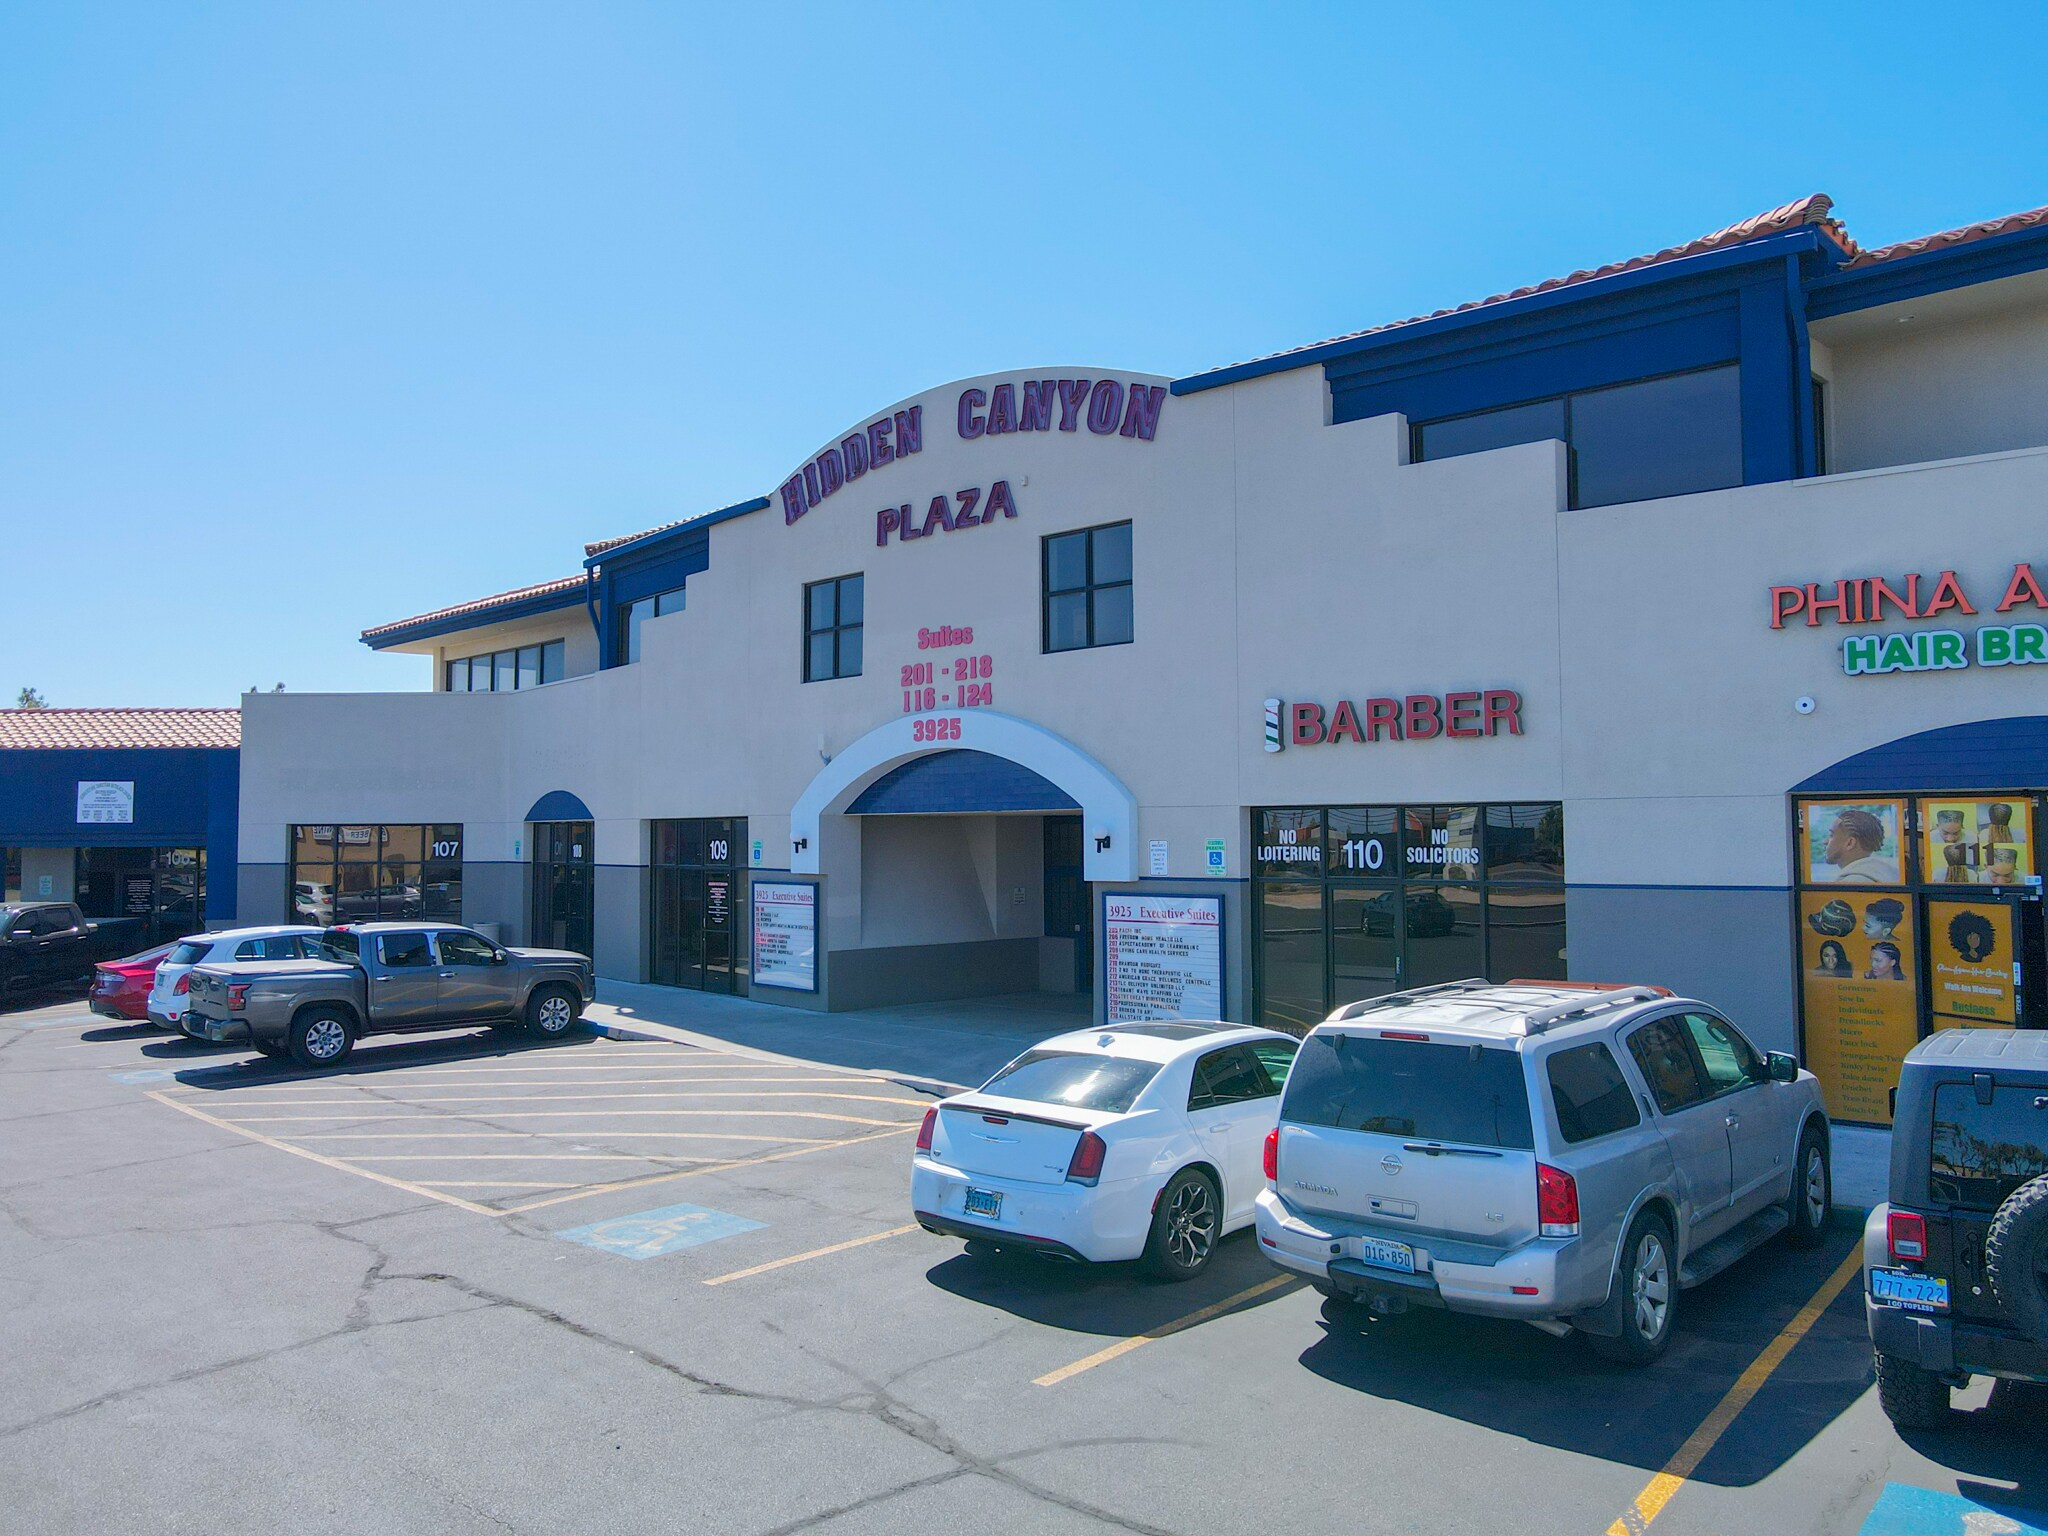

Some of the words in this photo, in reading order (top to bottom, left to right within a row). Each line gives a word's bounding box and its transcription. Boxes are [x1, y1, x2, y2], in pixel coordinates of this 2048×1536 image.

[779, 404, 922, 526] HIDDEN
[957, 379, 1167, 442] CANYON
[876, 480, 1017, 547] PLAZA
[1769, 571, 1978, 629] PHINA
[918, 625, 973, 650] Suites
[1845, 631, 1967, 674] HAIR
[1979, 625, 2048, 666] BR
[901, 662, 932, 687] 201
[955, 655, 992, 681] 218
[903, 687, 935, 712] 116
[957, 682, 992, 707] 124
[1292, 689, 1524, 745] BARBER
[913, 718, 961, 742] 3925
[1279, 830, 1296, 845] NO
[1431, 829, 1448, 845] NO
[432, 841, 459, 857] 107
[709, 840, 727, 860] 109
[1257, 846, 1321, 862] LOITERING
[1343, 839, 1383, 869] 110
[1406, 846, 1479, 864] SOLICITORS
[1955, 843, 1994, 866] 111
[772, 891, 796, 902] Executive
[797, 891, 813, 903] Suites
[1109, 906, 1132, 917] 3925
[1140, 906, 1185, 919] Executive
[1187, 908, 1216, 920] Suites
[1952, 1001, 1995, 1016] Business
[1295, 1180, 1338, 1196] ARMADA
[1375, 1240, 1400, 1249] NEVADA
[1903, 1302, 1934, 1312] TOPLESS
